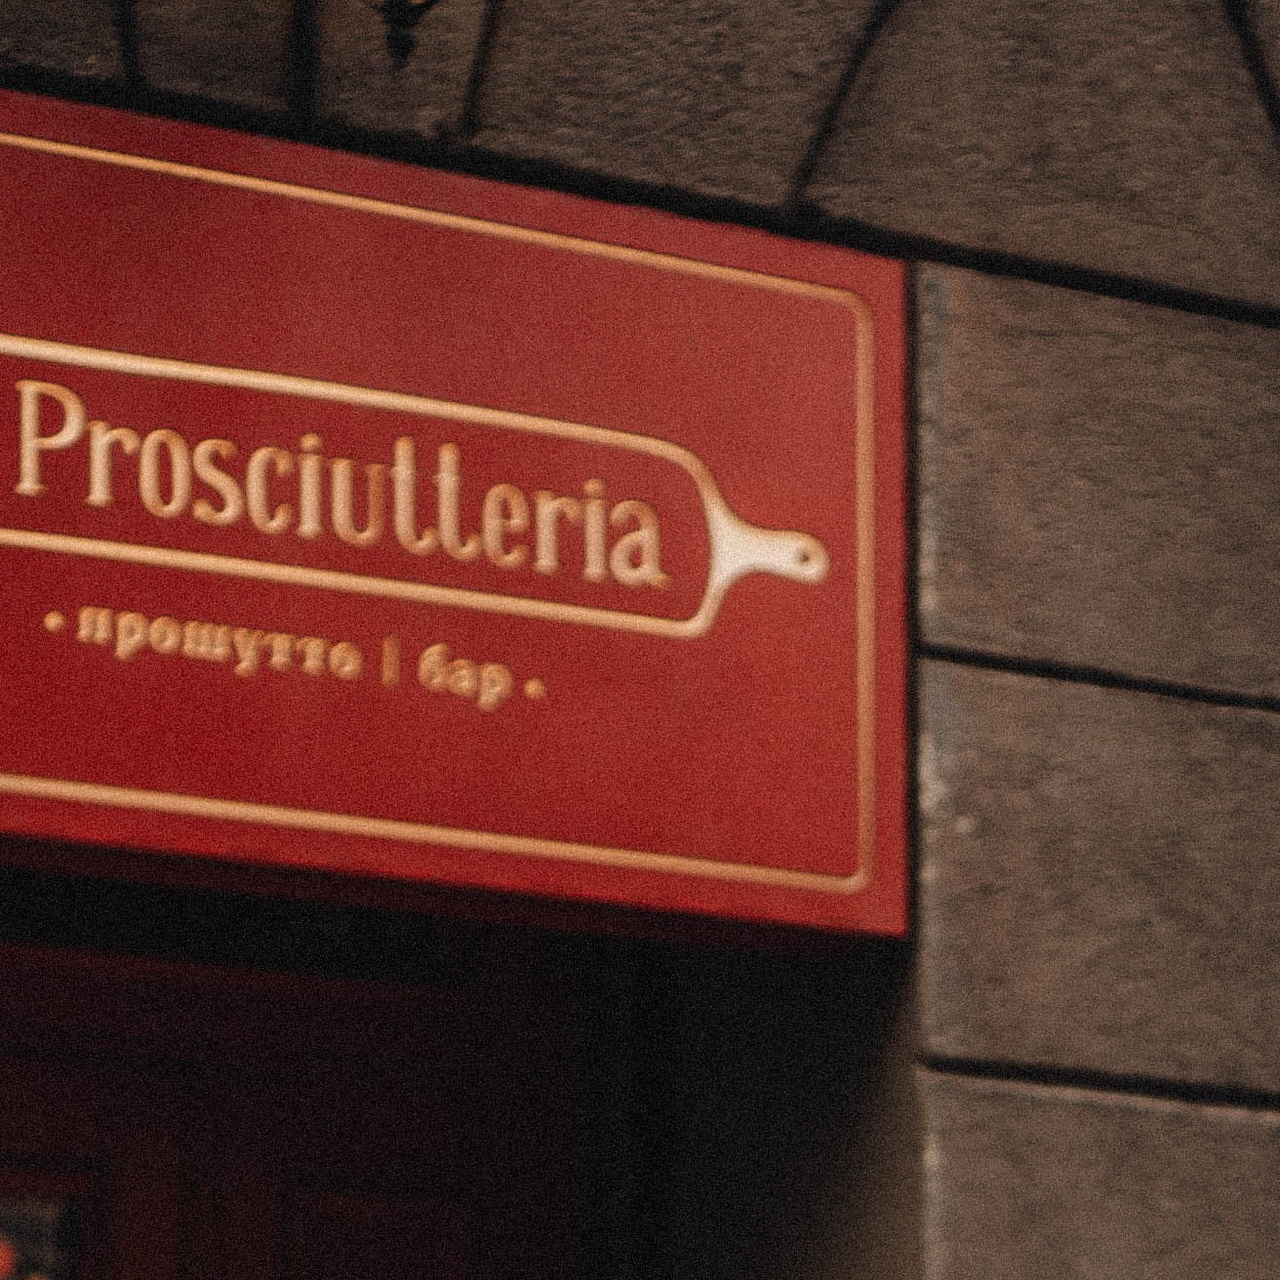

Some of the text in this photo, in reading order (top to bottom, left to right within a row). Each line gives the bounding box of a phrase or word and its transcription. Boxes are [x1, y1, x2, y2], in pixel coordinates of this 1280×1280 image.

[14, 378, 672, 590] Prosciutteria
[77, 605, 513, 712] прошутто бар
